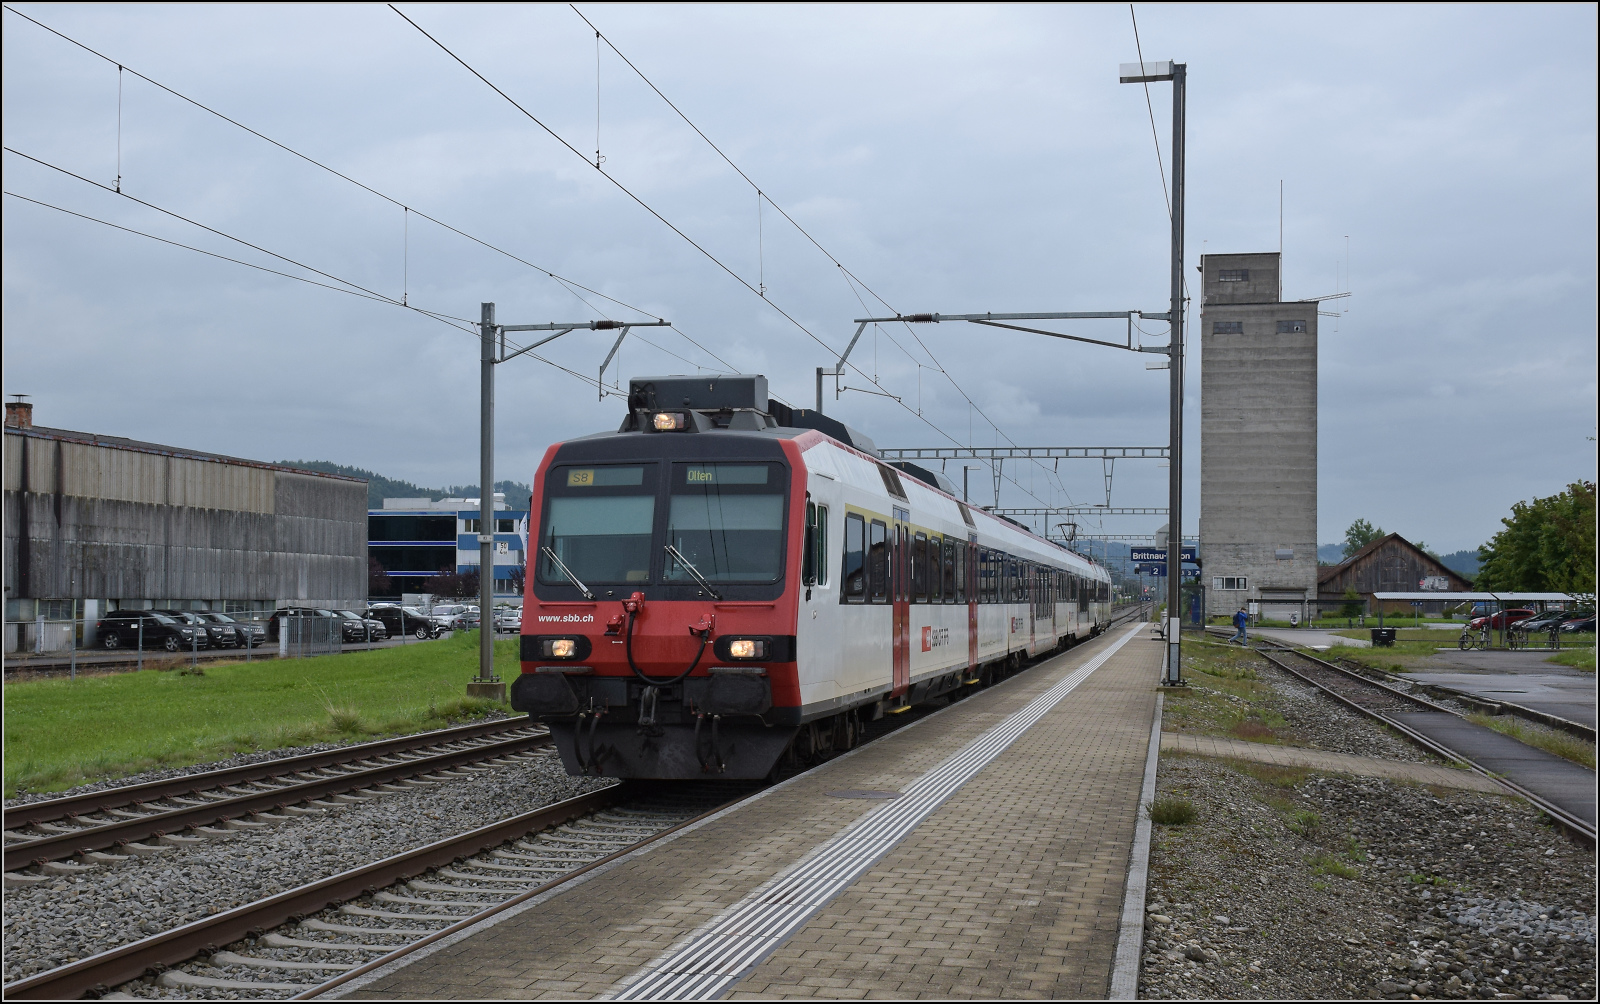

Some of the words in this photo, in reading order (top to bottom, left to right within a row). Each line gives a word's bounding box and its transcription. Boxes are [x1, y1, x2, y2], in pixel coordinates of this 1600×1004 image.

[573, 472, 589, 483] S8
[687, 470, 712, 481] Olten
[538, 613, 594, 623] www.sbb.ch
